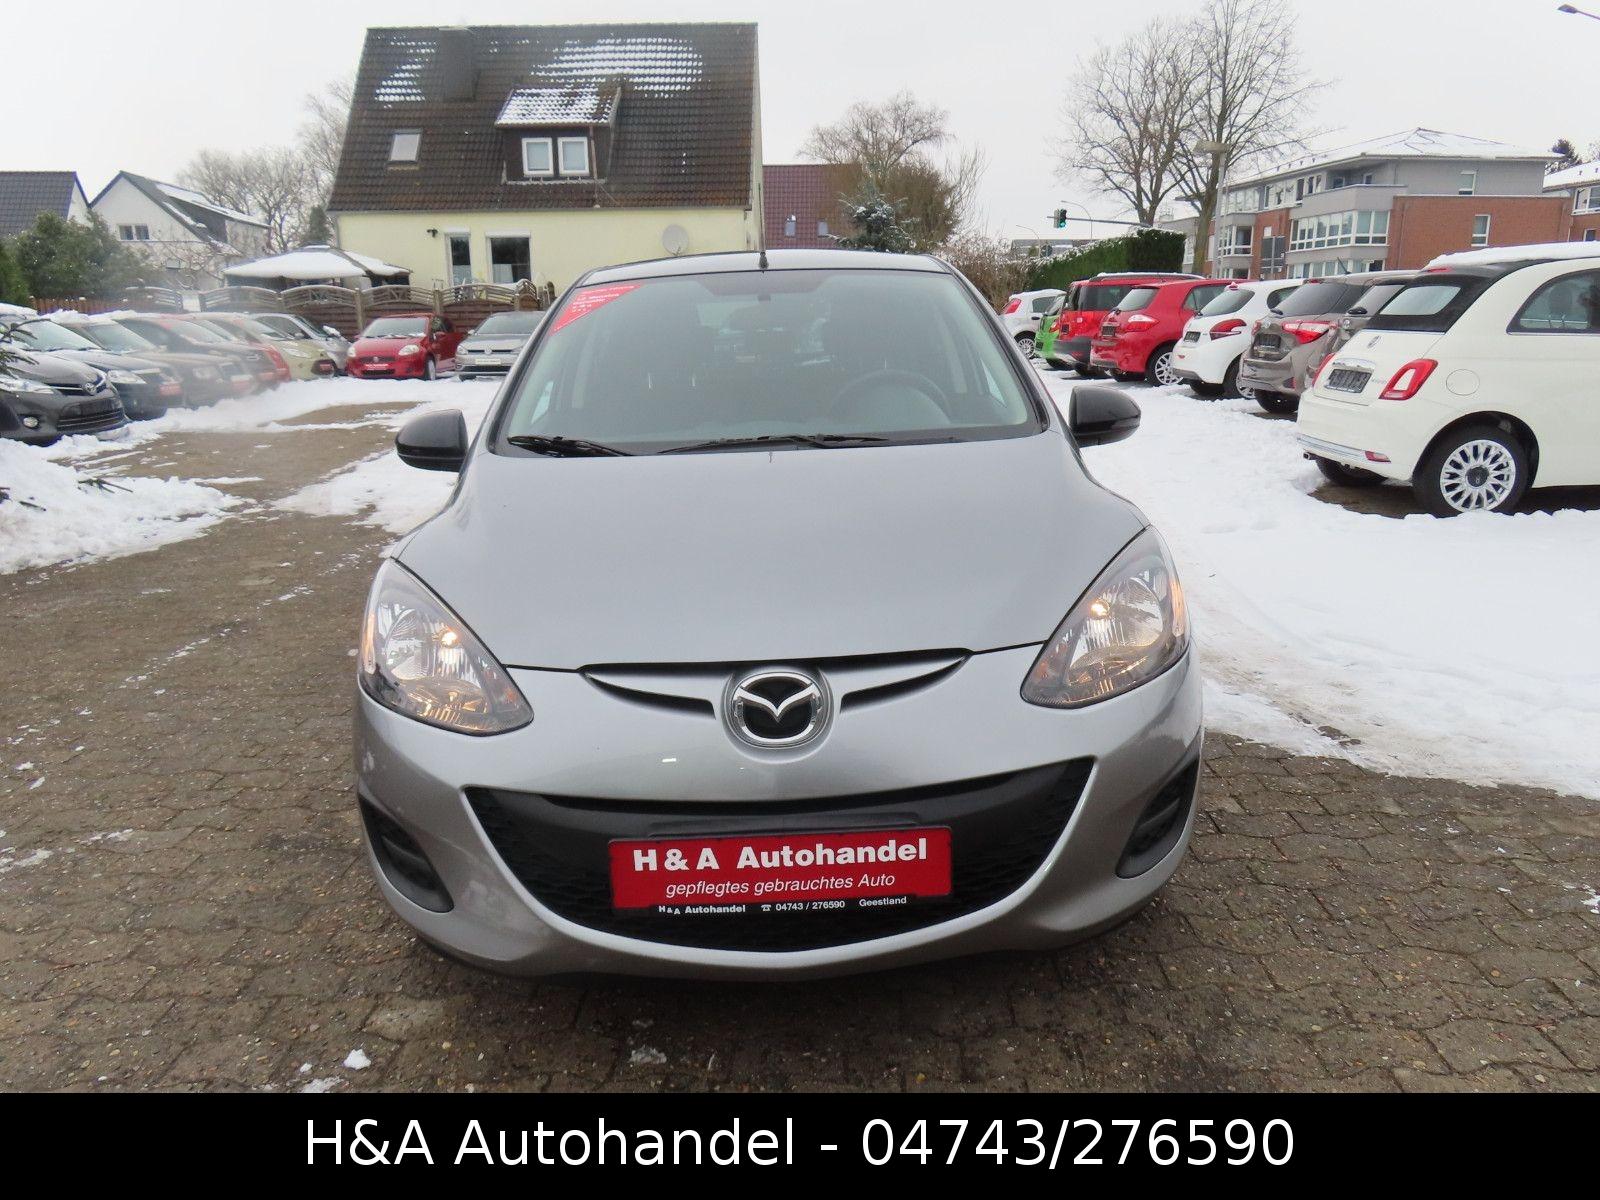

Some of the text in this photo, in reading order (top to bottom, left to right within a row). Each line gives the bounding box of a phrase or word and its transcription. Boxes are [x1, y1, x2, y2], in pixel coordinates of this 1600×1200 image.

[736, 837, 928, 869] Autohandel
[665, 873, 896, 898] gepflegtes gebrauchtes Auto
[684, 904, 746, 914] Autohandel
[858, 895, 907, 907] Geestland
